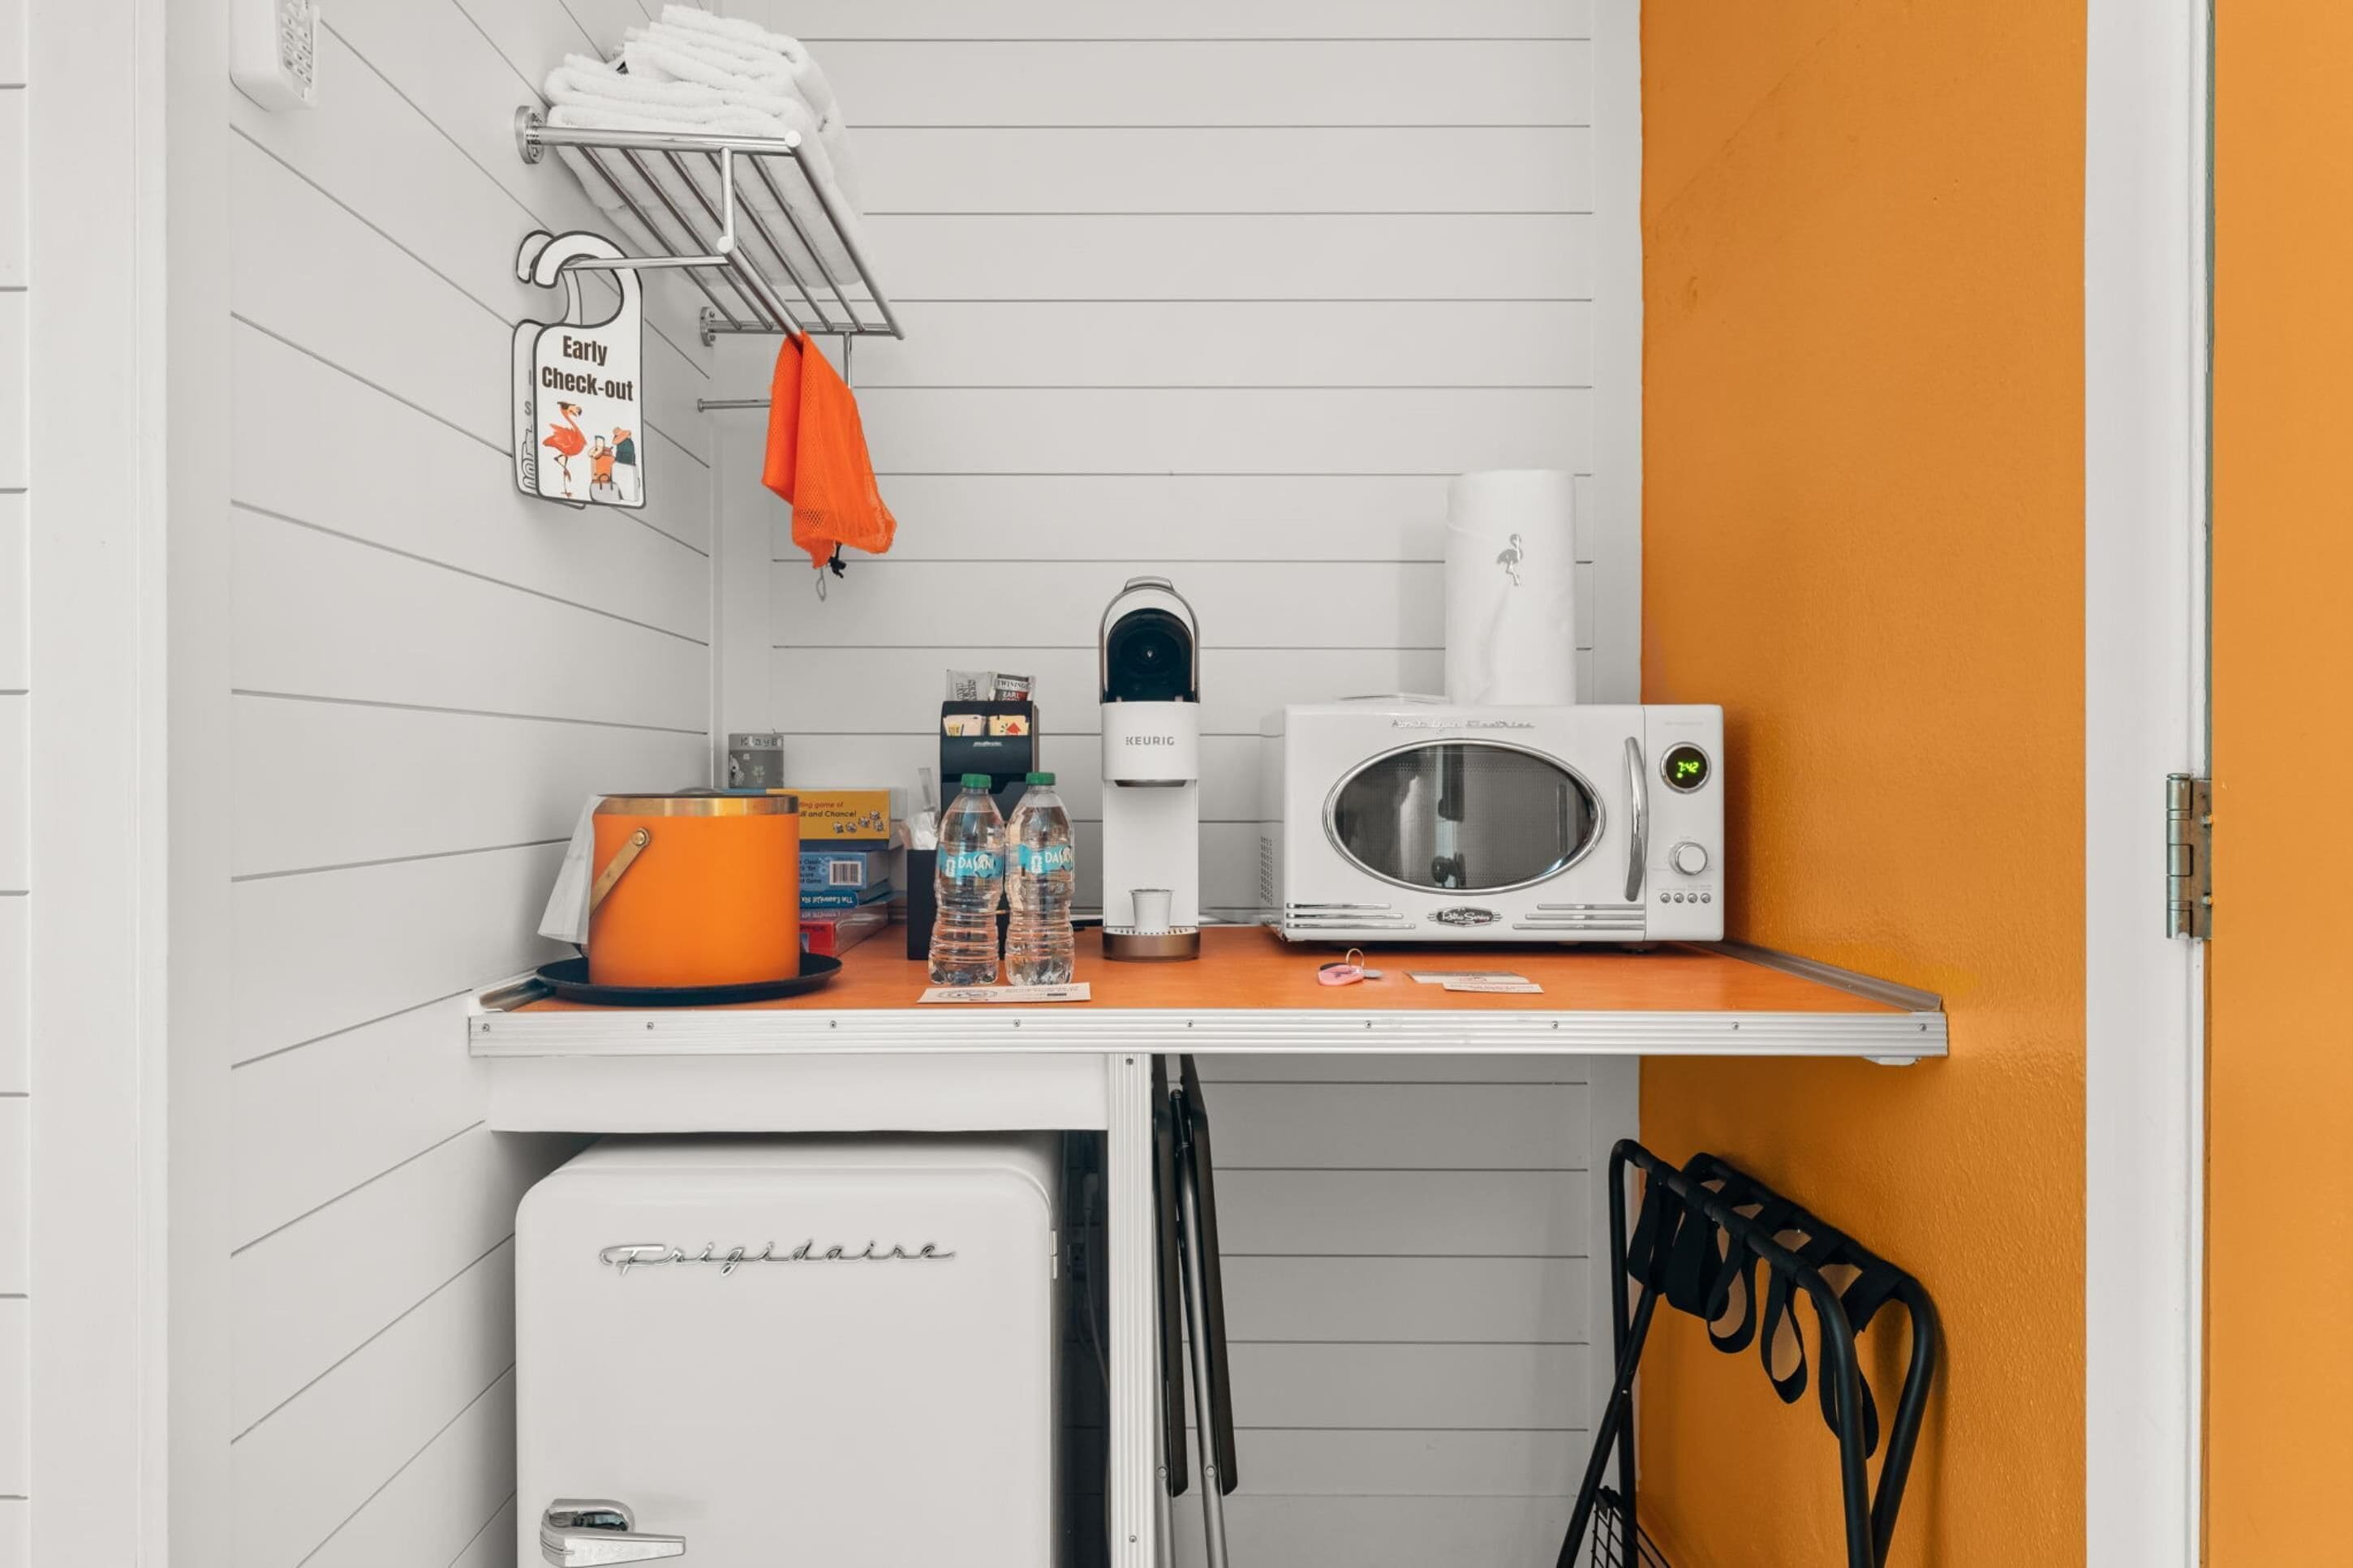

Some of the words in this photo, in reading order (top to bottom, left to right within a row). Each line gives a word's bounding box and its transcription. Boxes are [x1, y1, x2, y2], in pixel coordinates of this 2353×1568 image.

[563, 335, 608, 367] Early
[541, 366, 634, 402] Check-out
[1003, 690, 1020, 698] EARL
[1125, 736, 1175, 745] KEURIG
[1677, 761, 1700, 773] 7:42
[958, 854, 996, 871] DASANI
[1044, 848, 1073, 865] DASAN
[599, 1238, 956, 1277] Frigidaire
